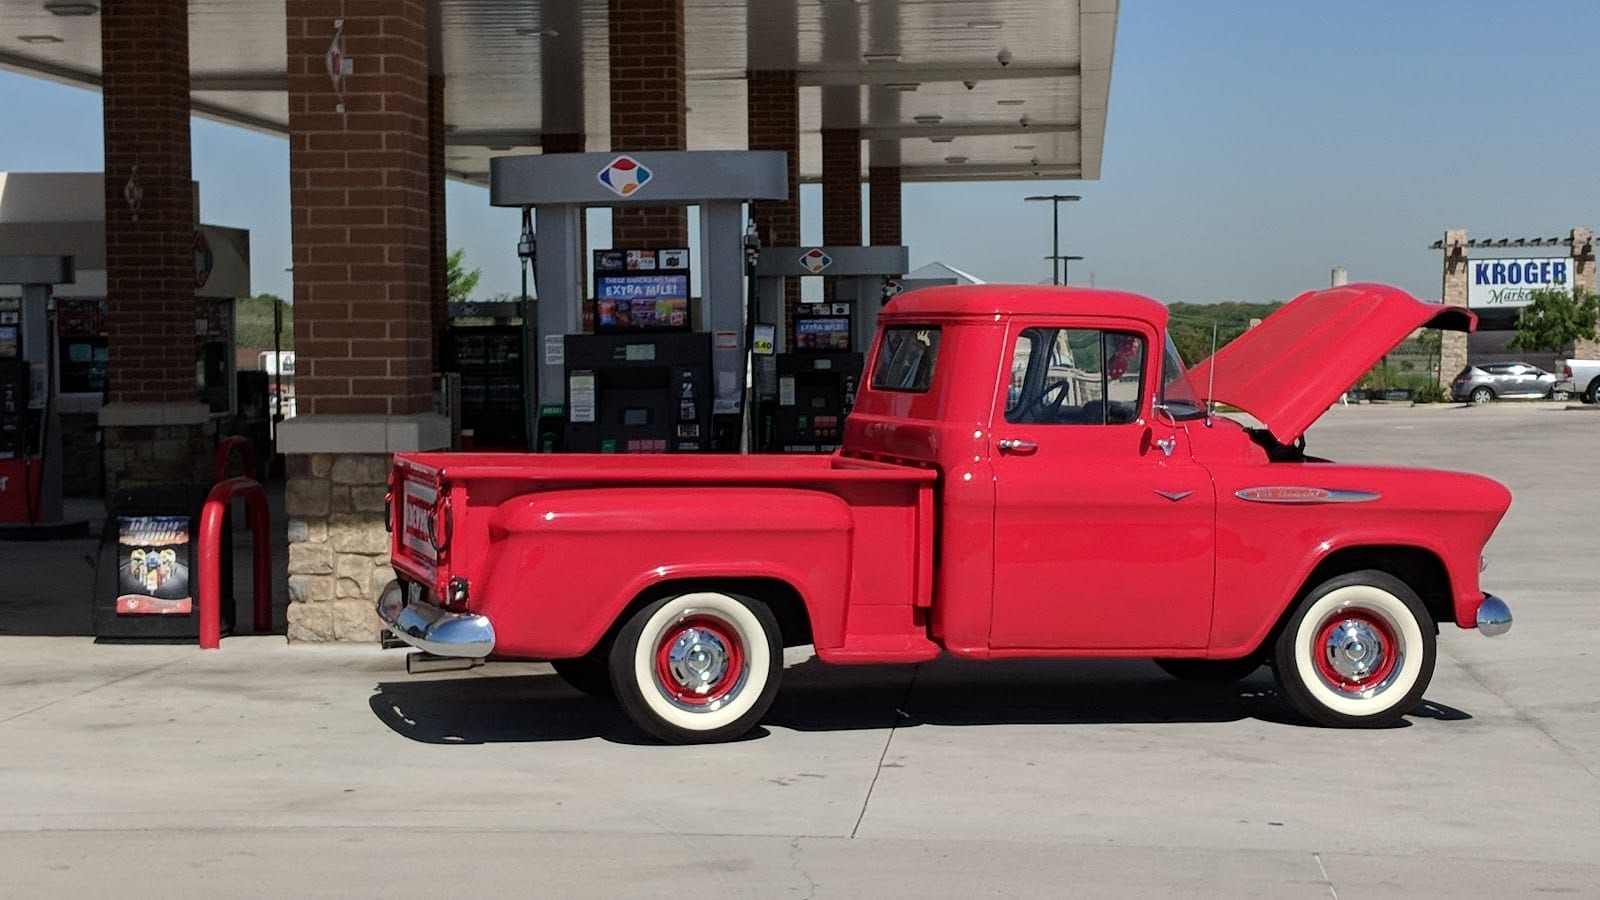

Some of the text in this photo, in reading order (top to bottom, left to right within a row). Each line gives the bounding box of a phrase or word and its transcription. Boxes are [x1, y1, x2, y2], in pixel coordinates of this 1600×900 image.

[1475, 262, 1567, 285] KROGER
[606, 284, 677, 296] EXTRA MILE!
